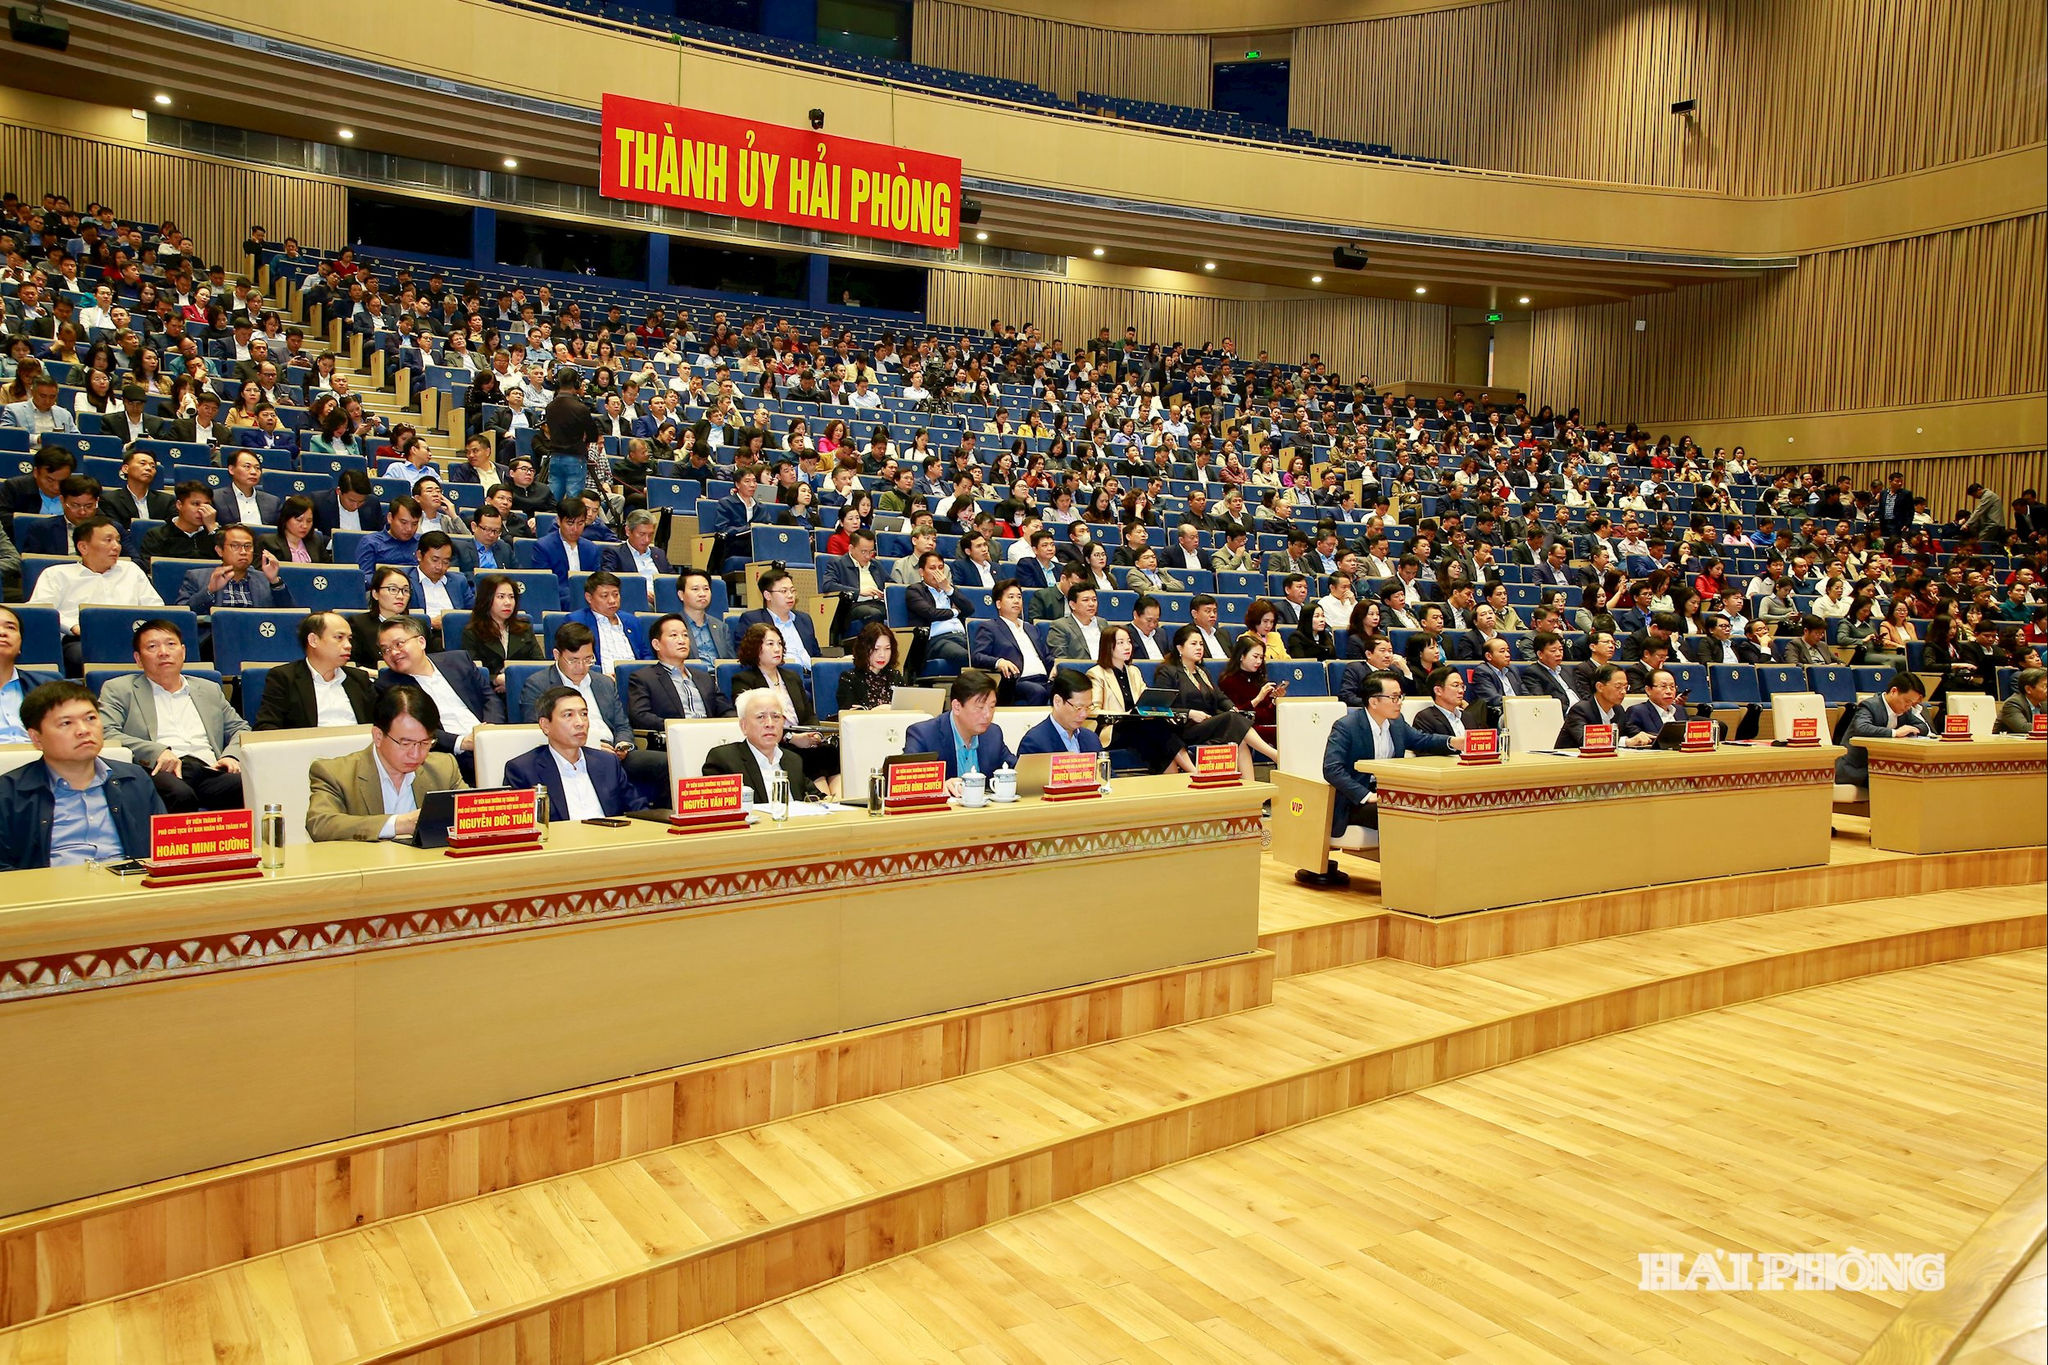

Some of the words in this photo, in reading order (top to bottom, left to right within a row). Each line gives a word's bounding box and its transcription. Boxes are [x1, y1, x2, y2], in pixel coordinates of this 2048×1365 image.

[615, 122, 728, 202] THÀNH
[738, 129, 780, 210] ỦY
[788, 142, 840, 220] HẢI
[850, 162, 952, 237] PHÒNG
[892, 781, 910, 793] NGUYỄN
[683, 796, 709, 810] NGUYỄN
[710, 796, 723, 807] VĂN
[1292, 802, 1302, 812] VIP
[459, 813, 492, 829] NGUYỄN
[494, 813, 510, 827] ĐỨC
[512, 810, 533, 825] TUẤN
[157, 842, 189, 857] HOÀNG
[192, 841, 216, 854] MINH
[219, 837, 249, 851] CƯỜNG
